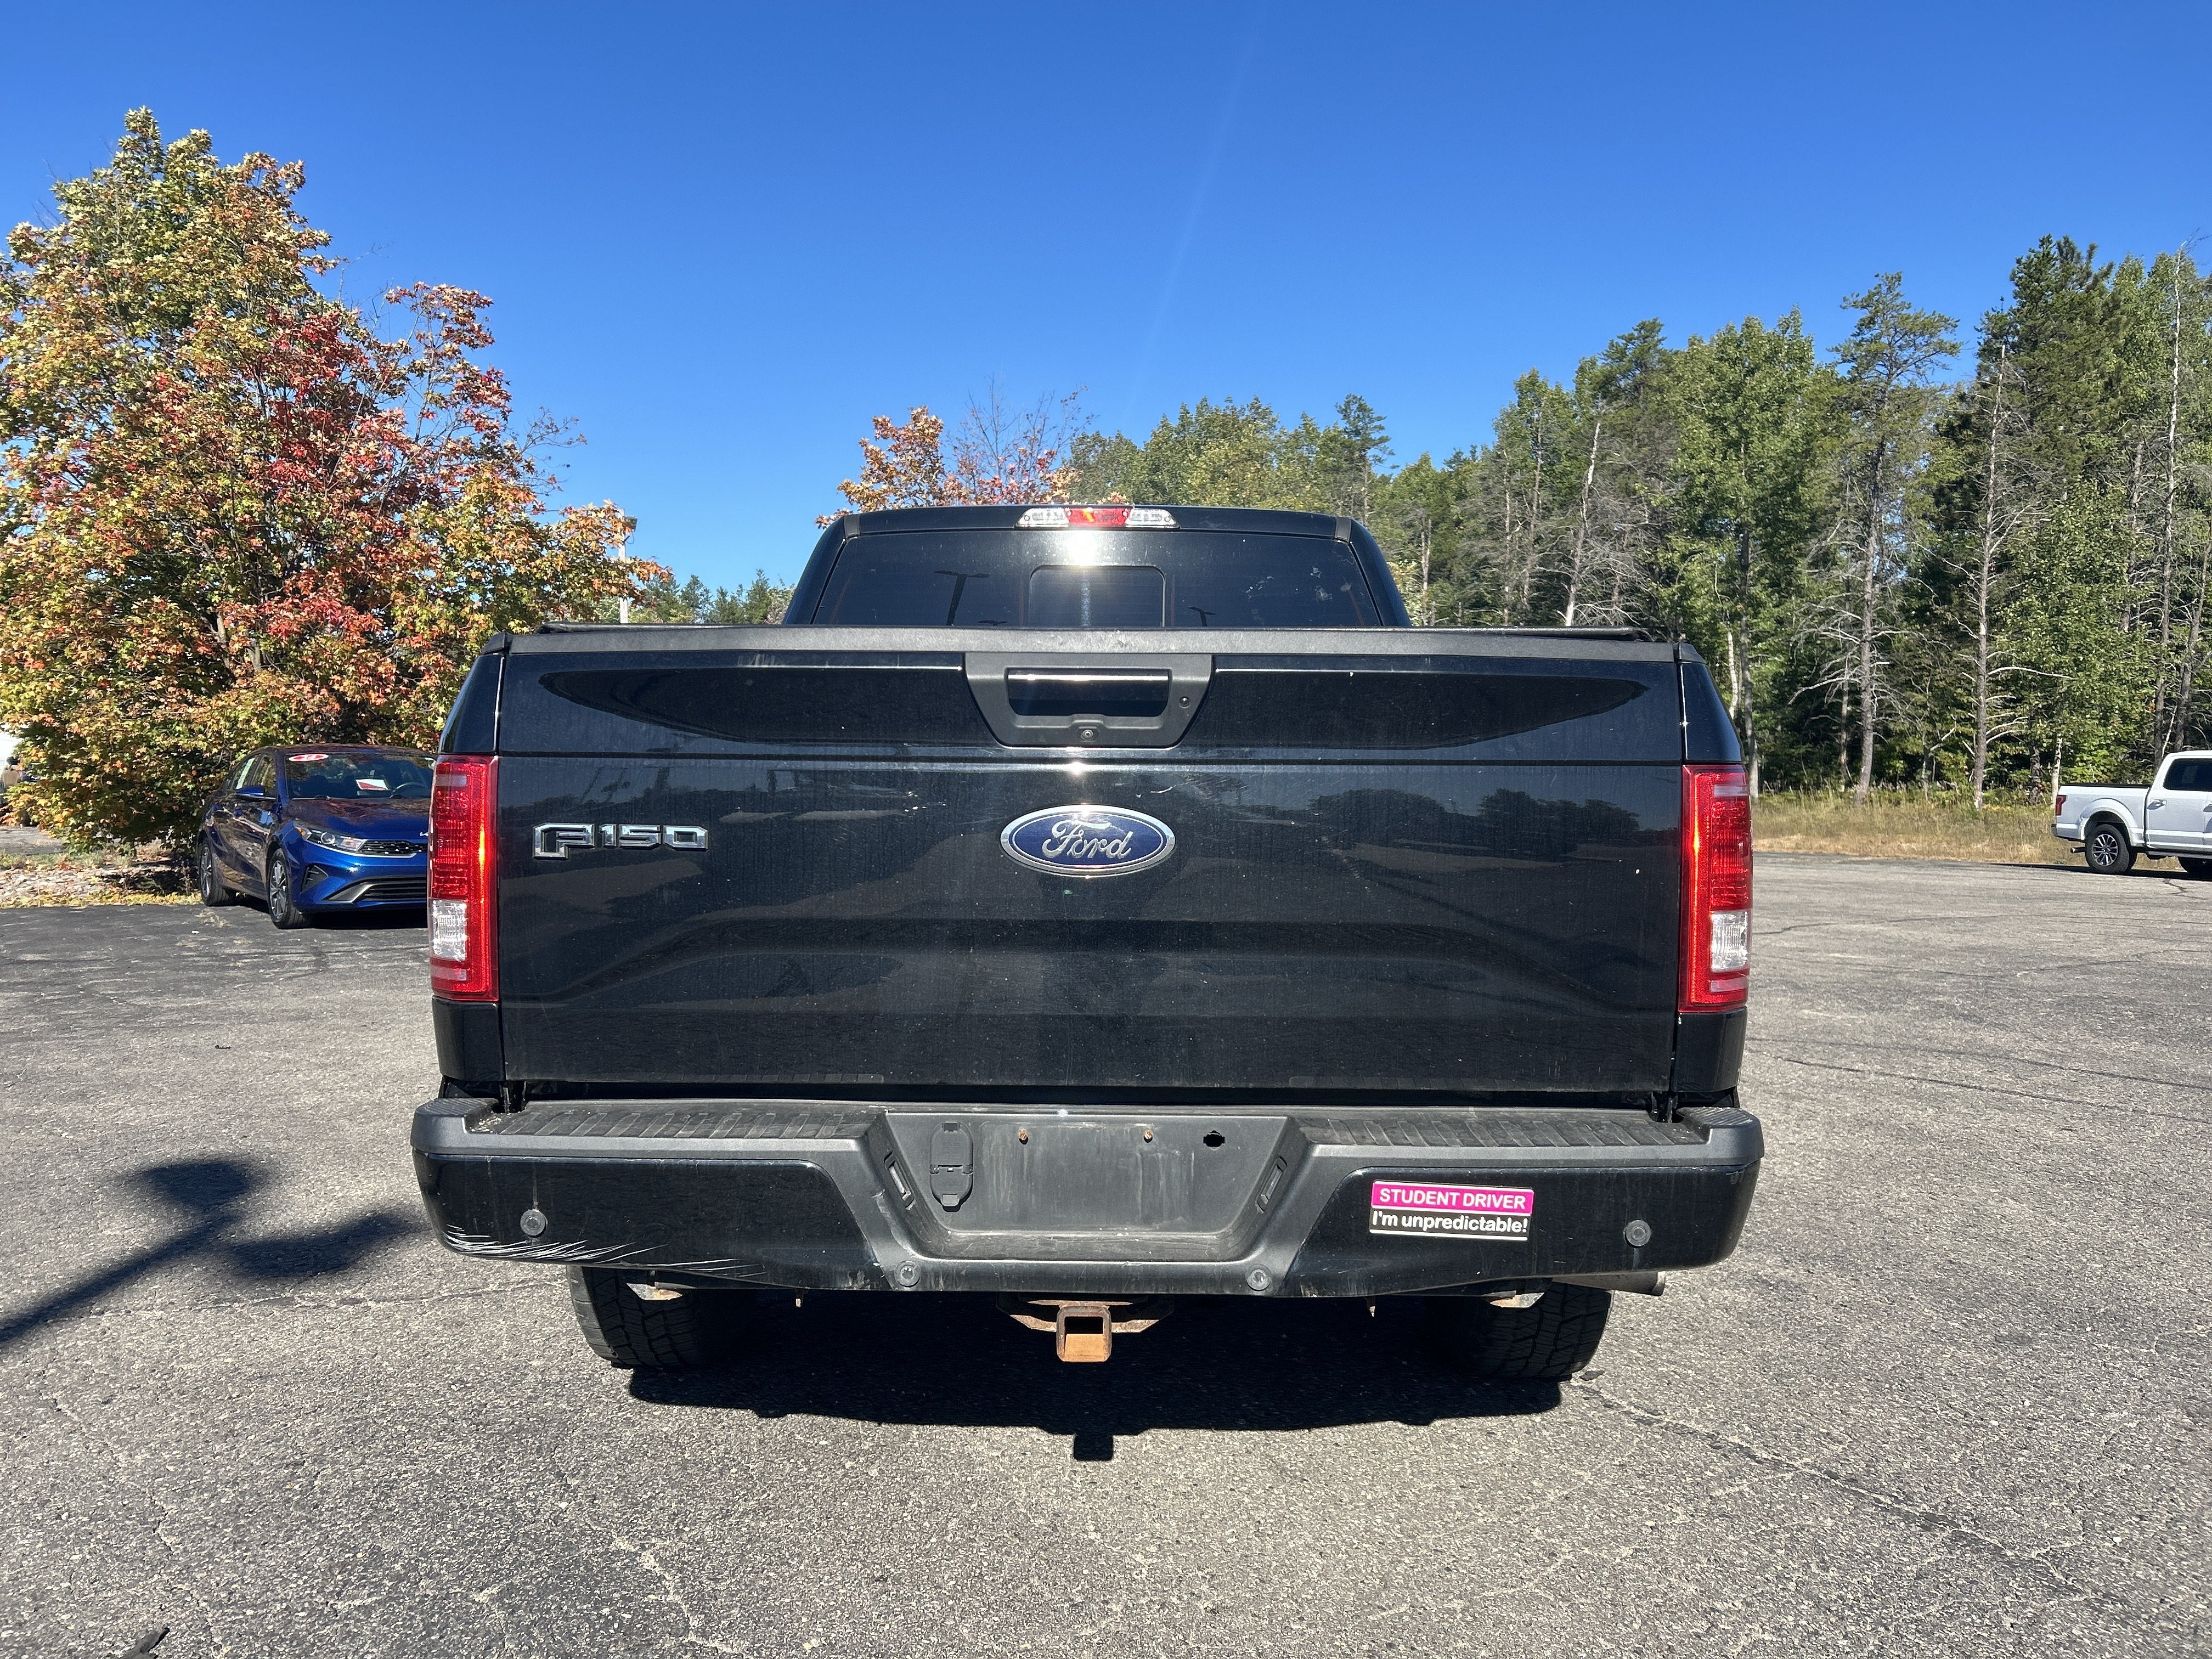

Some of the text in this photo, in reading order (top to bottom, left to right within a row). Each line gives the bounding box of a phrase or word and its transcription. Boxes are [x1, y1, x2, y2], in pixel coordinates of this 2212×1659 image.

[1042, 820, 1134, 858] Ford
[1379, 1188, 1526, 1210] STUDENT DRIVER
[1372, 1210, 1528, 1233] I'm unpredictable!
